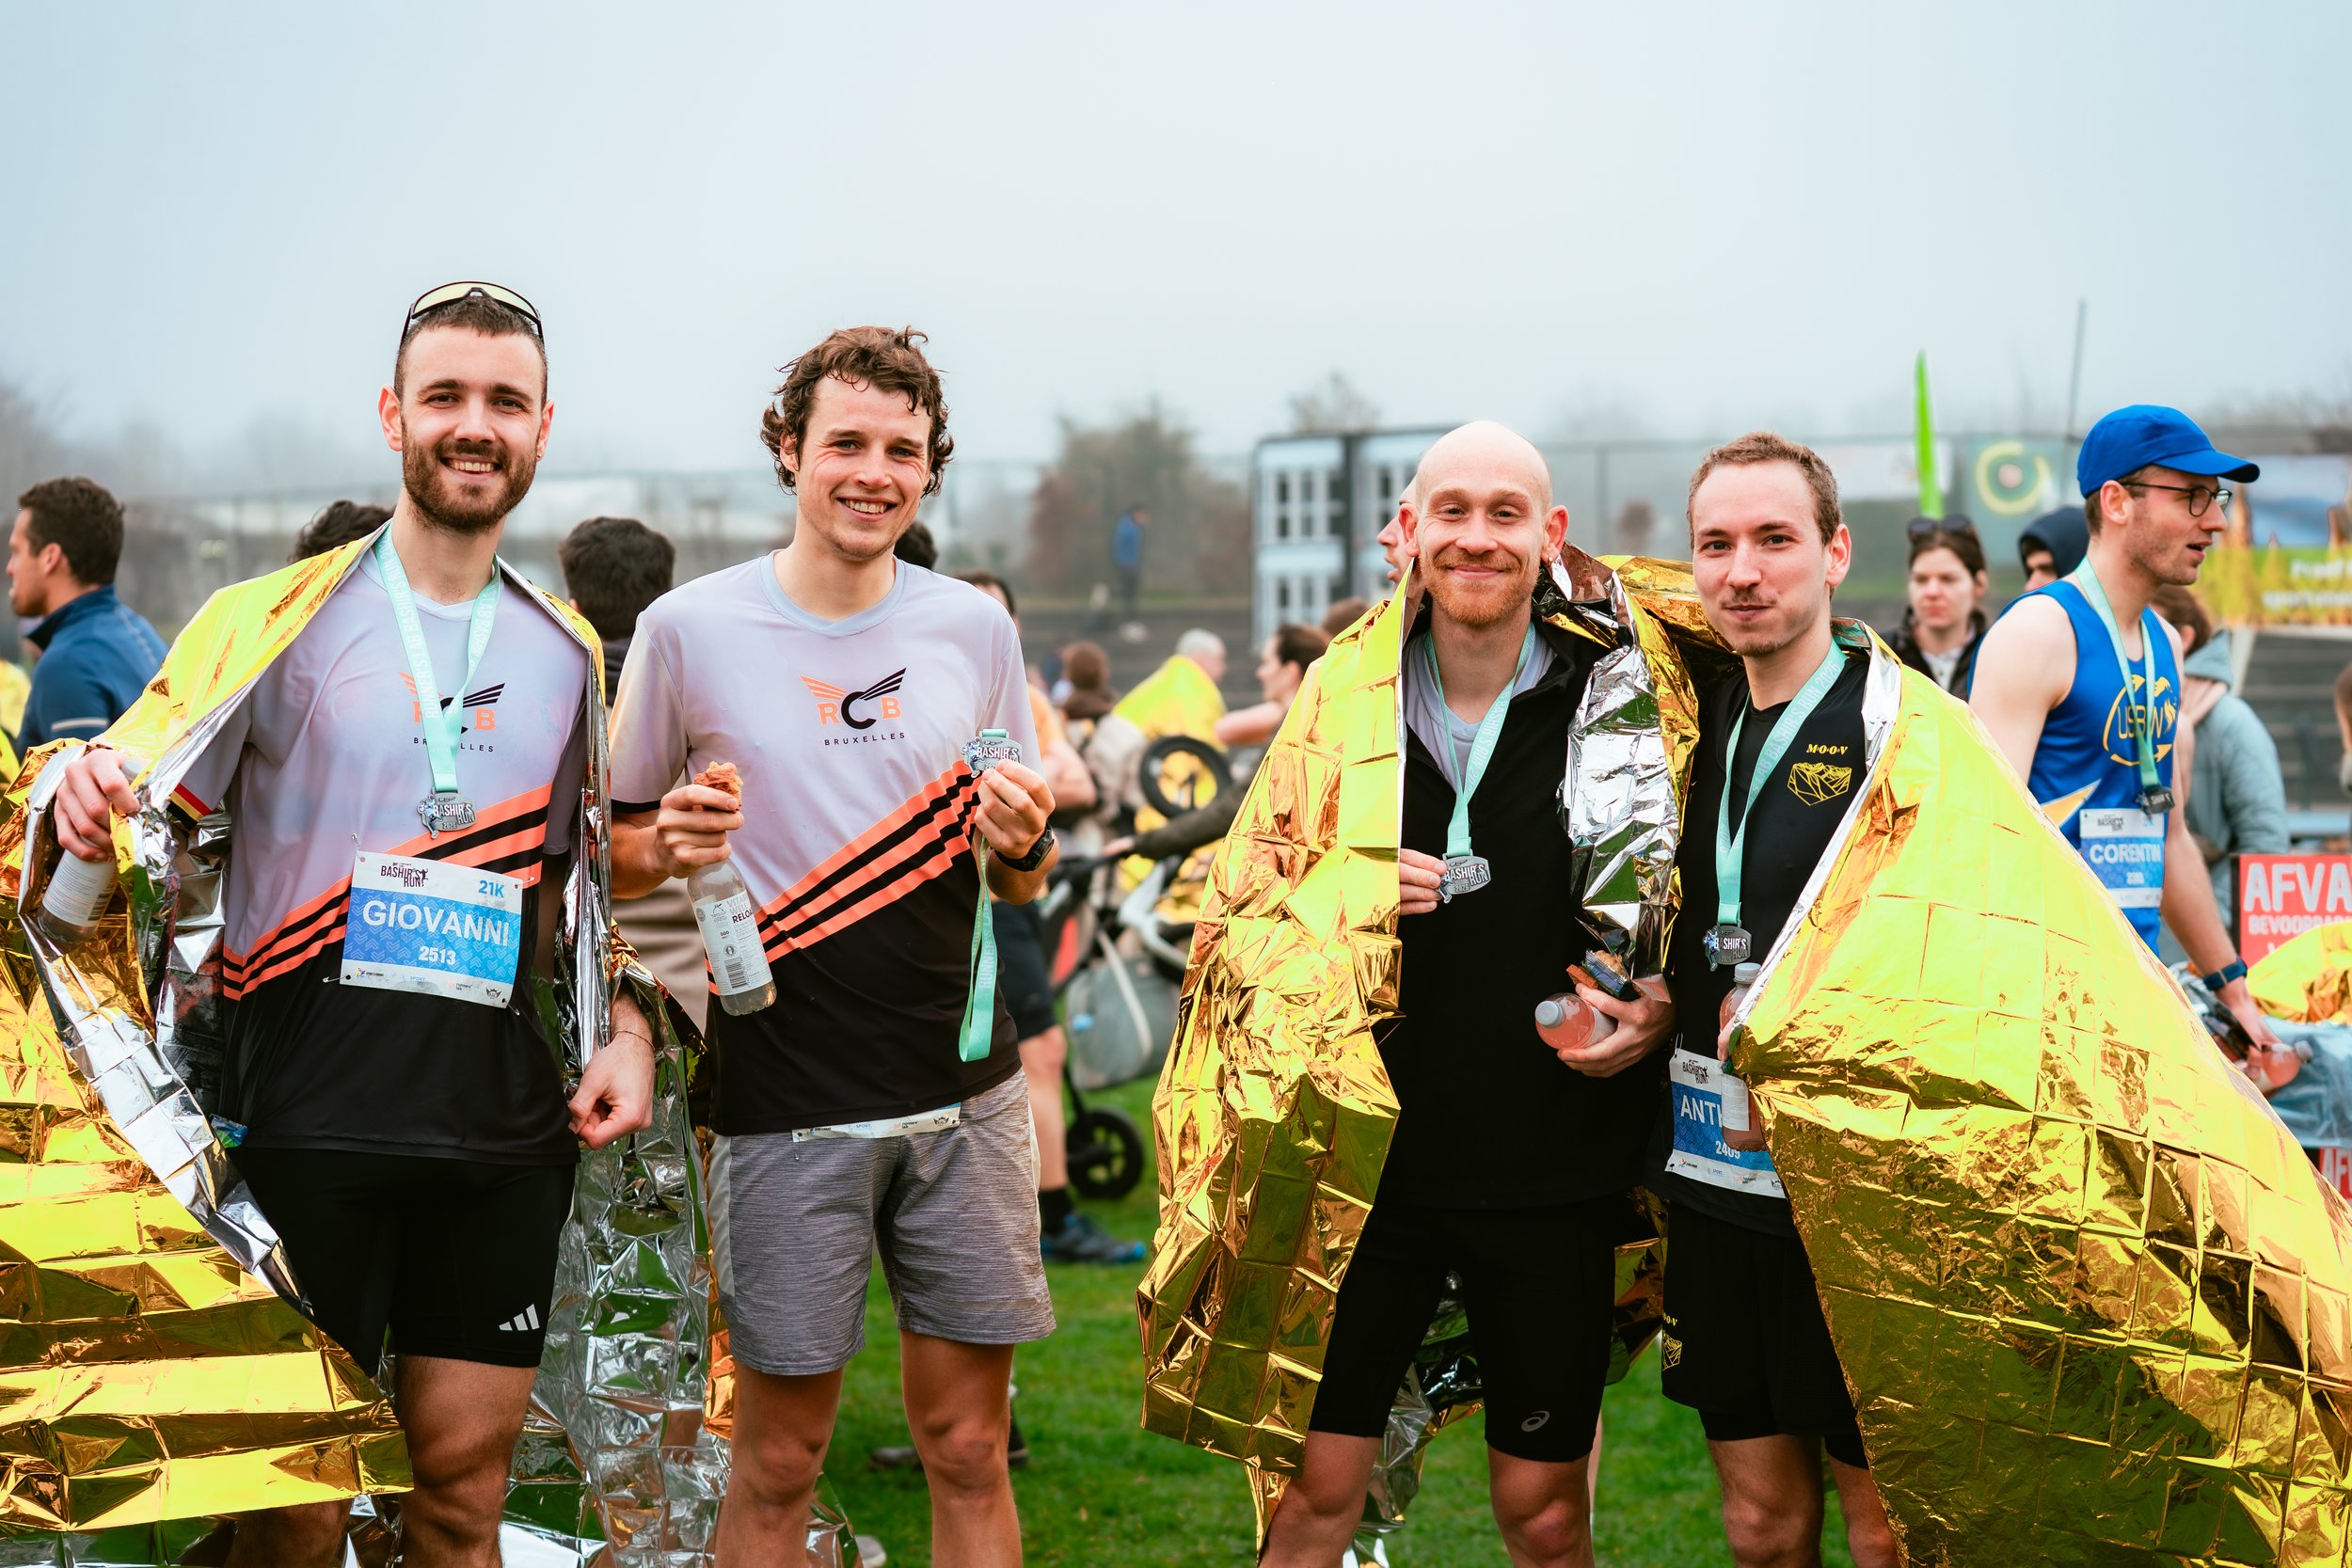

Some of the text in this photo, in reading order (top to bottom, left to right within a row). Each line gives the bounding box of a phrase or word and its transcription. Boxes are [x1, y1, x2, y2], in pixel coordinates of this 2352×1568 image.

[383, 560, 402, 584] RUN
[389, 580, 420, 632] BASHIR'S
[405, 634, 427, 658] LAB
[1767, 708, 1806, 760] BASHIR'S
[1796, 685, 1821, 711] RUN
[1814, 660, 1841, 689] 2026
[413, 736, 494, 752] BRLLES
[824, 732, 905, 746] BRUXELLES
[1472, 747, 1489, 769] RUN
[433, 802, 473, 816] BASHIR'S
[456, 811, 476, 825] RUN
[2089, 843, 2162, 864] CORENTIN
[380, 864, 421, 879] BASHIR'S
[1444, 863, 1486, 882] BASHIR'S
[1469, 870, 1489, 886] RUN
[477, 879, 506, 898] 21K
[363, 900, 509, 946] GIOVANNI
[418, 945, 457, 966] 2513
[977, 929, 995, 989] RUNNER'S
